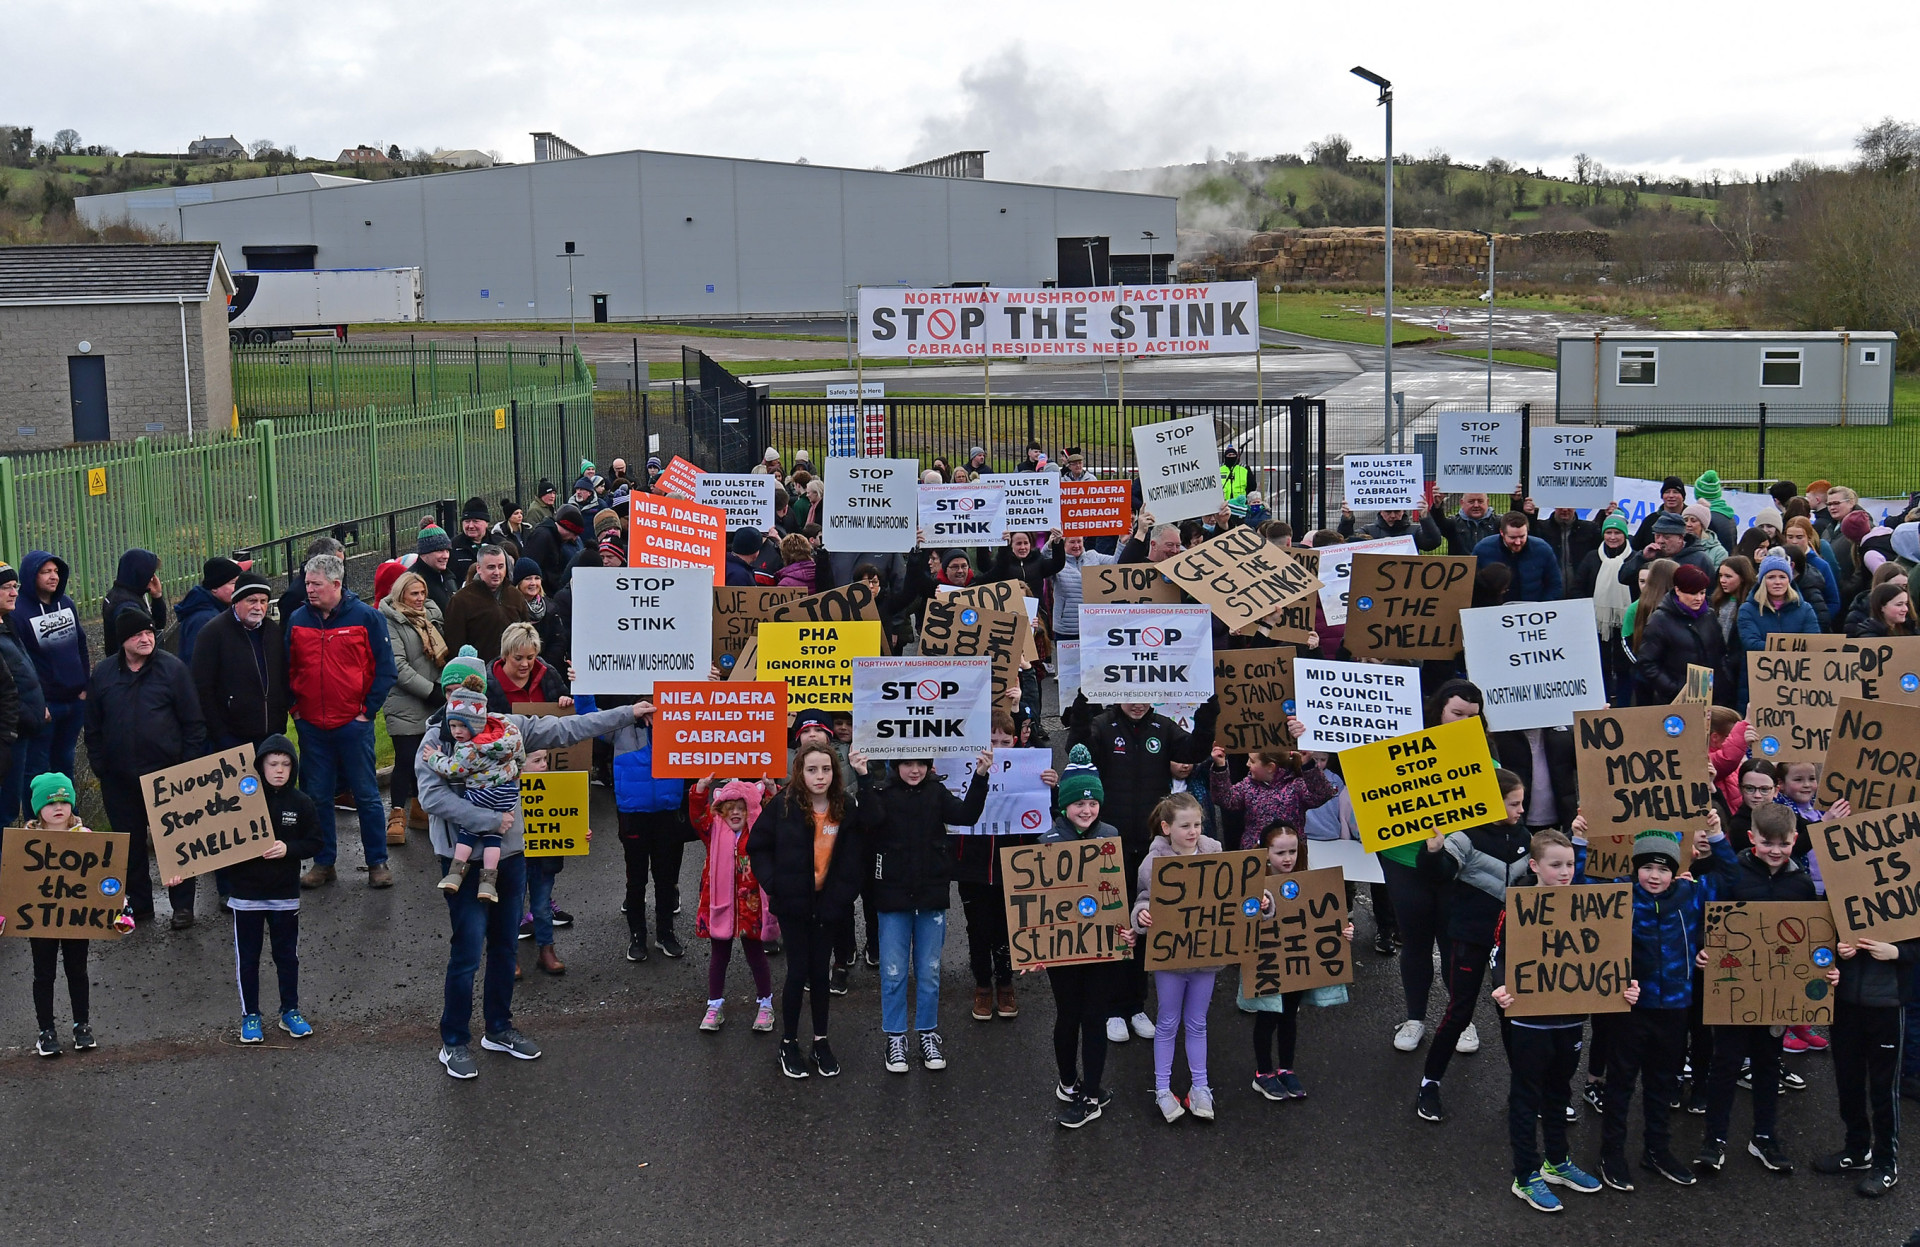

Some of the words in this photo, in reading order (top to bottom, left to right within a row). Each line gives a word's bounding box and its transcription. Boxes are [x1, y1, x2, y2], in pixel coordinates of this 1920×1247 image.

[905, 292, 1000, 305] NORTHWAY
[1008, 290, 1115, 303] MUSHROOM
[1124, 287, 1208, 301] FACTORY
[872, 307, 984, 340] STOP
[1004, 307, 1087, 340] THE
[1110, 302, 1249, 340] STINK
[907, 343, 985, 354] CABRAGH
[993, 342, 1086, 353] RESIDENTS
[1093, 342, 1138, 353] NEED
[1145, 340, 1209, 352] ACTION
[1156, 425, 1195, 443] STOP
[1461, 422, 1500, 431] STOP
[1472, 434, 1490, 442] THE
[1554, 434, 1593, 444] STOP
[1167, 445, 1187, 456] THE
[1460, 447, 1498, 456] STINK
[673, 460, 688, 472] NIEA
[1161, 461, 1200, 476] STINK
[1373, 460, 1412, 468] ULSTER
[1444, 465, 1475, 475] NORTHWAY
[1476, 465, 1512, 476] MUSHROOMS
[1553, 462, 1592, 470] STINK
[849, 469, 894, 479] STOP
[1359, 470, 1405, 478] COUNCIL
[1537, 476, 1569, 487] NORTHWAY
[1570, 476, 1608, 487] MUSHROOMS
[725, 480, 764, 488] ULSTER
[861, 484, 883, 493] THE
[1061, 487, 1084, 496] NIEA
[1087, 486, 1125, 495] /DAERA
[1358, 487, 1407, 495] CABRAGH
[848, 497, 892, 508] STINK
[1354, 497, 1412, 505] RESIDENTS
[635, 500, 667, 517] NIEA
[671, 508, 718, 527] /DAERA
[1068, 508, 1119, 518] CABRAGH
[636, 516, 658, 529] HAS
[660, 523, 695, 536] FAILED
[697, 529, 717, 540] THE
[830, 516, 865, 529] NORTHWAY
[867, 516, 908, 529] MUSHROOMS
[934, 522, 990, 534] STINK
[1065, 519, 1123, 530] RESIDENTS
[646, 535, 711, 557] CABRAGH
[1173, 549, 1222, 582] GET
[1213, 528, 1267, 561] RID
[616, 578, 675, 591] STOP
[1099, 567, 1158, 594] STOP
[1376, 561, 1468, 591] STOP
[1226, 563, 1312, 617] STINK!!
[630, 596, 660, 607] THE
[1384, 598, 1438, 618] THE
[617, 617, 676, 630] STINK
[1501, 611, 1558, 628] STOP
[799, 628, 838, 641] PHA
[1108, 626, 1182, 647] STOP
[1367, 623, 1456, 649] SMELL!
[1518, 629, 1547, 642] THE
[800, 646, 836, 655] STOP
[1509, 647, 1566, 666] STINK
[588, 654, 636, 671] NORTHWAY
[639, 654, 694, 670] MUSHROOMS
[767, 660, 835, 669] IGNORING
[1755, 656, 1811, 682] SAVE
[1824, 660, 1862, 683] OUR
[785, 675, 850, 686] HEALTH
[1104, 665, 1189, 682] STINK
[1306, 669, 1336, 681] MID
[1342, 672, 1404, 686] ULSTER
[660, 692, 704, 705] NIEA
[709, 692, 776, 705] /DAERA
[881, 680, 960, 700] STOP
[1224, 681, 1284, 705] STAND
[1320, 686, 1394, 701] COUNCIL
[1486, 686, 1532, 705] NORTHWAY
[1533, 679, 1587, 699] MUSHROOMS
[1777, 686, 1838, 706] SCHOOL
[662, 711, 691, 721] HAS
[695, 711, 743, 721] FAILED
[746, 711, 774, 721] THE
[907, 706, 934, 715] THE
[1241, 707, 1265, 722] the
[1307, 700, 1333, 711] HAS
[1338, 702, 1382, 713] FAILED
[1386, 705, 1412, 715] THE
[1318, 714, 1398, 730] CABRAGH
[1756, 708, 1795, 727] FROM
[675, 730, 765, 743] CABRAGH
[876, 719, 964, 738] STINK
[1580, 717, 1624, 750] NO
[1388, 736, 1437, 760] PHA
[668, 752, 772, 765] RESIDENTS
[1395, 757, 1438, 776] STOP
[1606, 749, 1682, 785] MORE
[1361, 773, 1442, 802] IGNORING
[1447, 762, 1482, 781] OUR
[1387, 786, 1466, 817] HEALTH
[549, 808, 578, 816] OUR
[1377, 802, 1488, 841] CONCERNS
[176, 816, 270, 866] SMELL!!
[24, 839, 114, 877] Stop!
[1866, 852, 1910, 886] IS
[38, 875, 87, 899] the
[1156, 856, 1261, 905] STOP
[1010, 895, 1073, 929] The
[1178, 902, 1238, 928] THE
[1515, 892, 1555, 926] WE
[1570, 890, 1628, 922] HAVE
[1282, 909, 1310, 975] THE
[1309, 893, 1344, 976] STOP
[1542, 927, 1600, 958] HAD
[1748, 951, 1810, 982] the
[1514, 960, 1631, 996] ENOUGH
[1730, 986, 1833, 1023] Pollution
